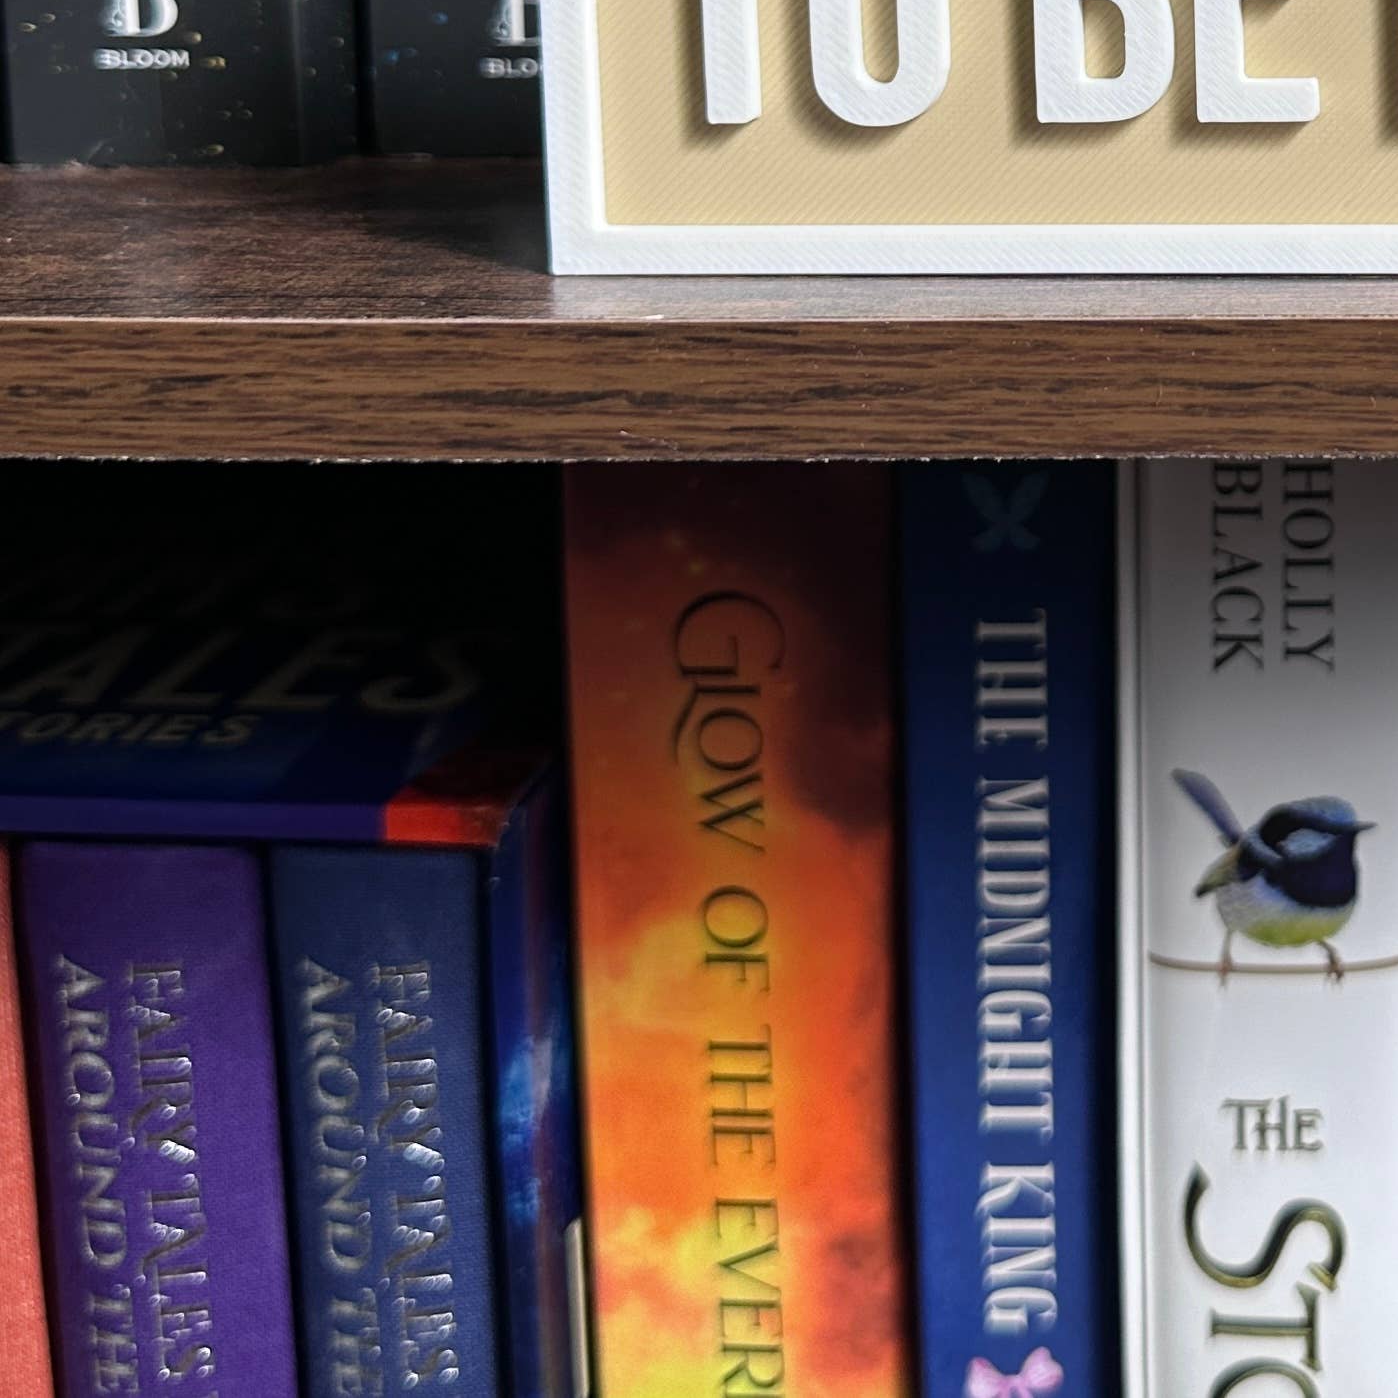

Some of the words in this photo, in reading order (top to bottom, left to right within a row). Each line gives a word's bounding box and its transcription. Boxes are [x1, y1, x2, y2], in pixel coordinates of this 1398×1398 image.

[95, 48, 190, 70] BLOOM
[1212, 460, 1264, 672] BLACK
[1283, 460, 1335, 670] HOLLY
[671, 590, 787, 853] GLOW
[976, 608, 1048, 750] THE
[702, 884, 770, 994] OF
[976, 777, 1055, 1141] MIDNIGHT
[56, 953, 129, 1268] AROUND
[123, 959, 198, 1164] FAIRY
[303, 955, 373, 1273] AROUND
[366, 960, 447, 1170] FAIRY
[705, 1025, 776, 1168] THE
[1220, 1096, 1324, 1152] THE
[89, 1283, 139, 1395] THE
[136, 1172, 214, 1382] TALES
[331, 1287, 384, 1398] THE
[380, 1174, 459, 1389] TALES
[714, 1198, 786, 1398] EVER
[977, 1159, 1058, 1336] KING
